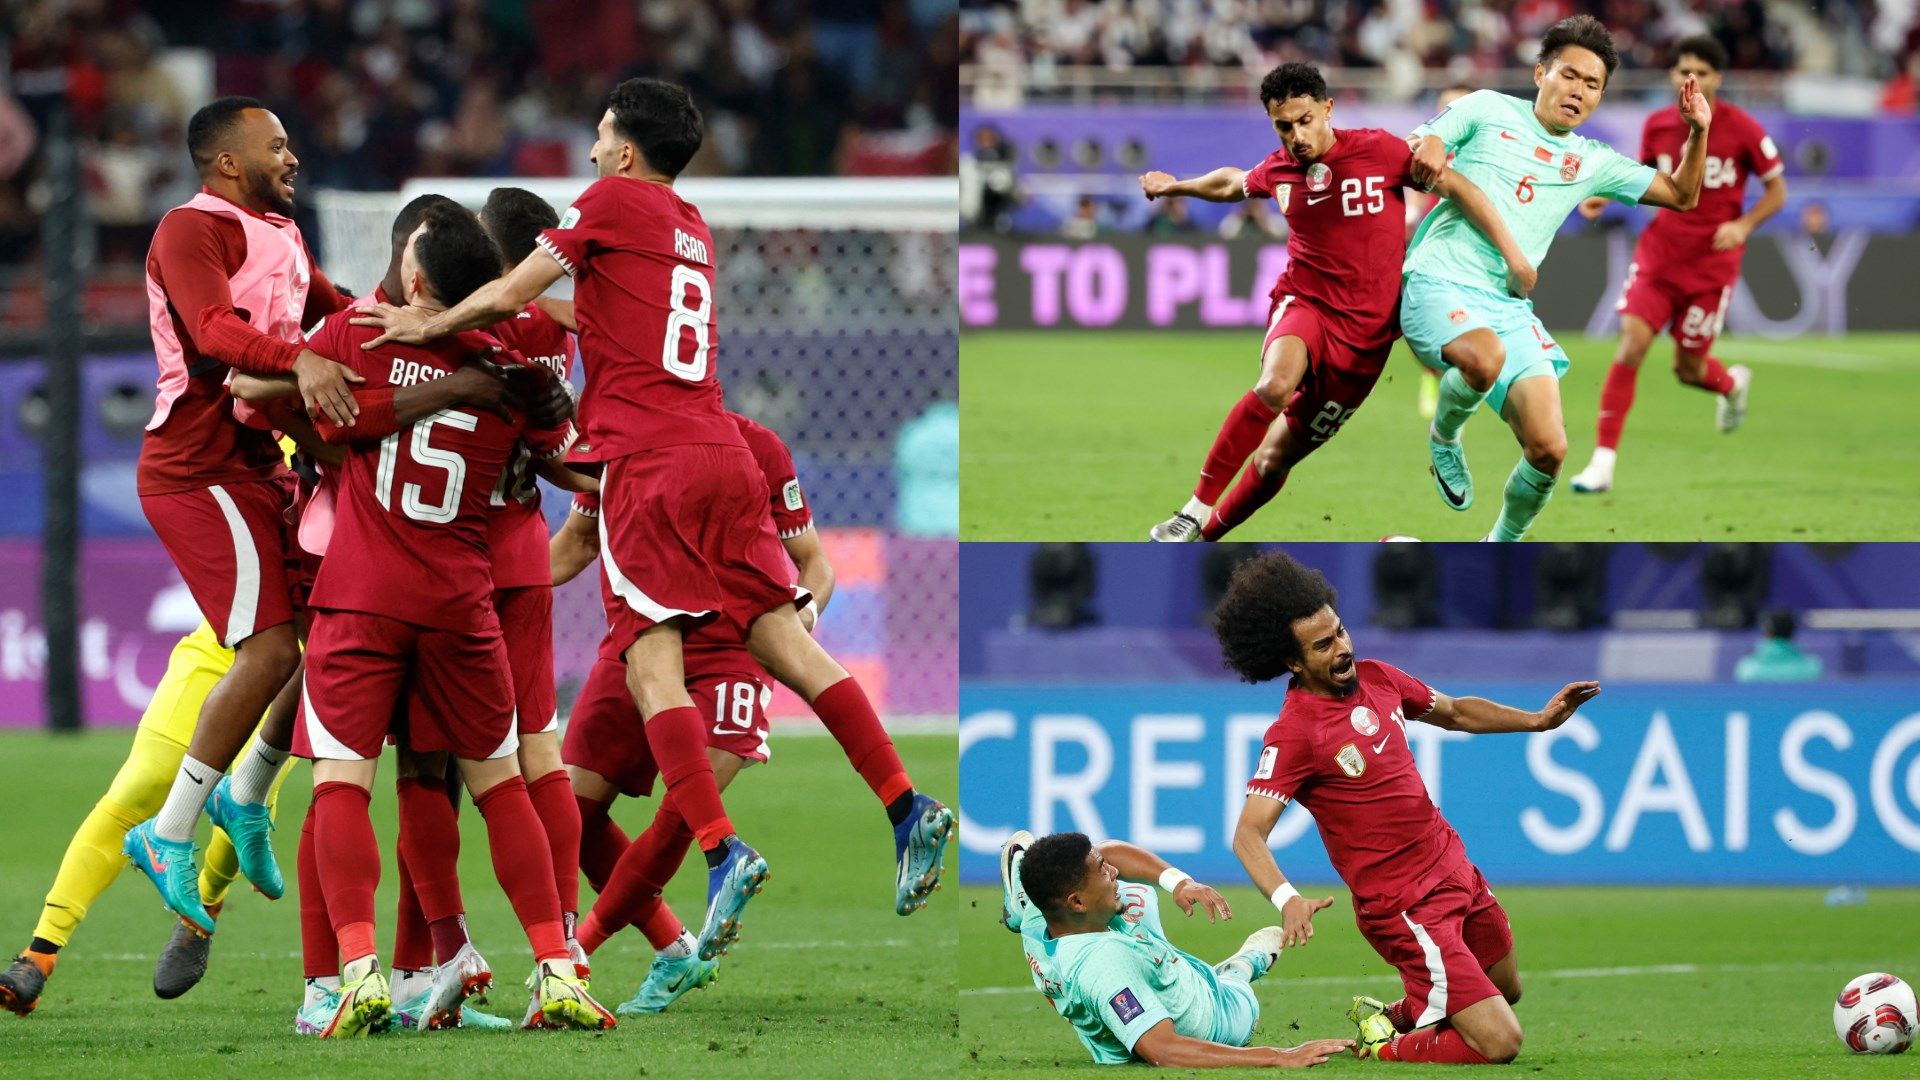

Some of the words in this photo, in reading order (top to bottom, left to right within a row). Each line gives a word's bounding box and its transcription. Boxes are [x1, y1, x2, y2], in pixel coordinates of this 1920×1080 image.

[1341, 176, 1385, 216] 25
[1516, 175, 1538, 204] 6
[674, 227, 709, 265] ASAD
[1019, 243, 1128, 326] TO
[662, 264, 712, 382] 8
[374, 408, 479, 524] 15
[714, 682, 754, 728] 18
[959, 710, 1475, 855] CREDT
